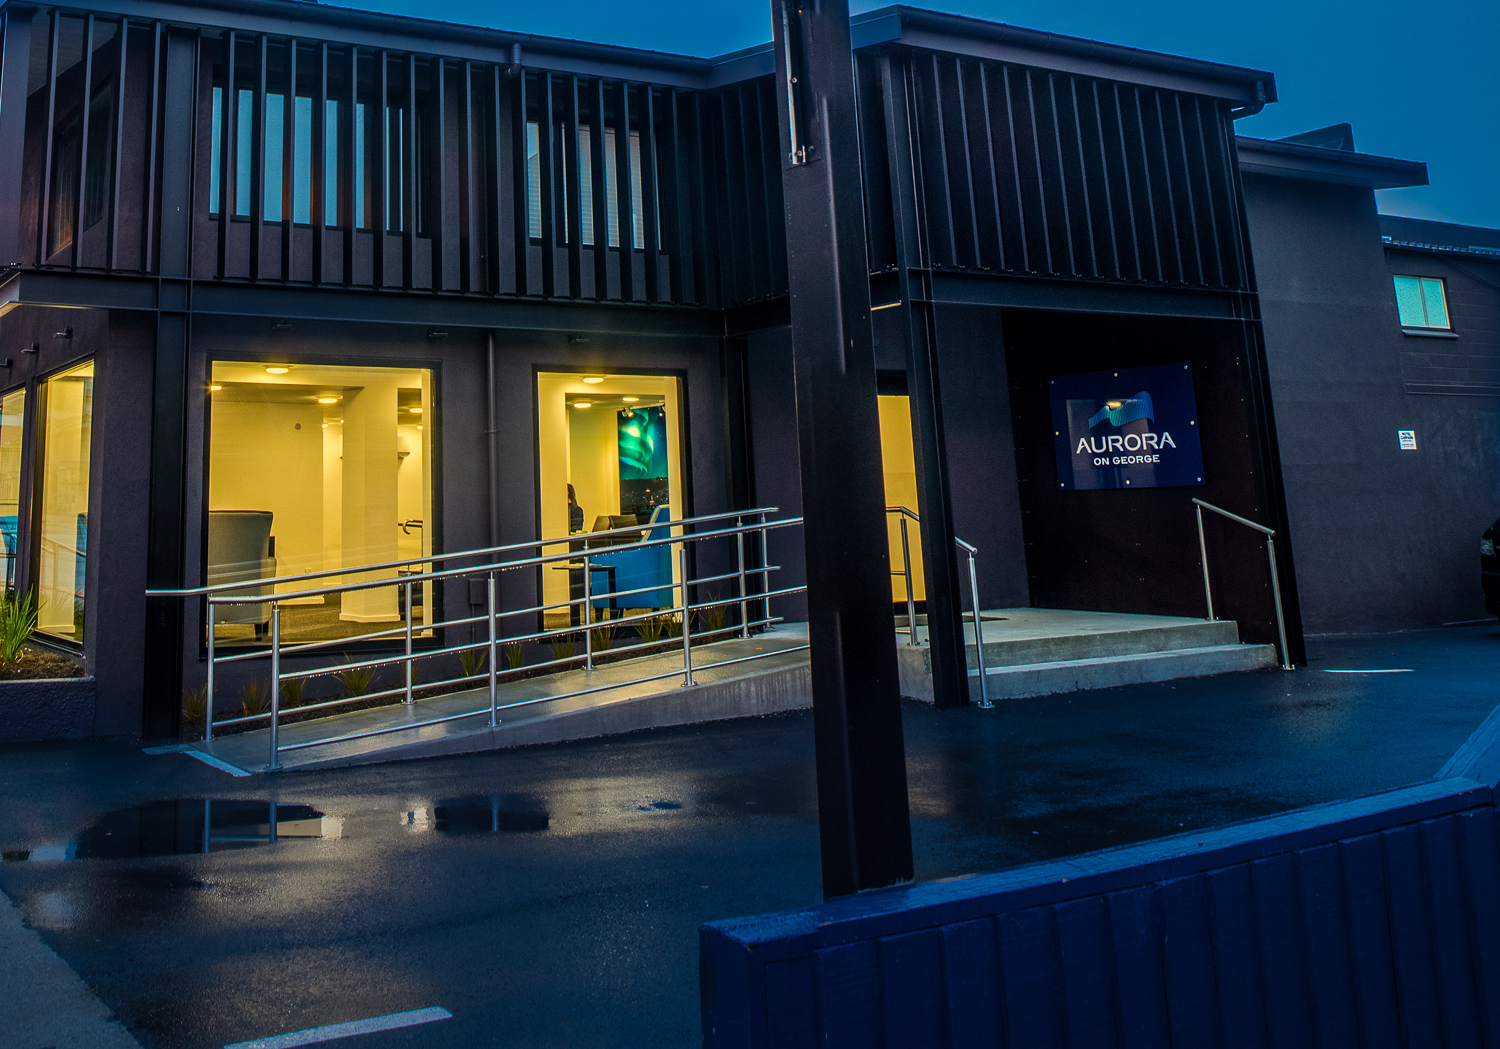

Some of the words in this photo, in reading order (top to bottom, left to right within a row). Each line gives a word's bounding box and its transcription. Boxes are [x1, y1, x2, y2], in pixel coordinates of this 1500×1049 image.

[1076, 431, 1177, 454] AURORA
[1093, 457, 1110, 466] ON
[1112, 454, 1161, 465] GEORGE
